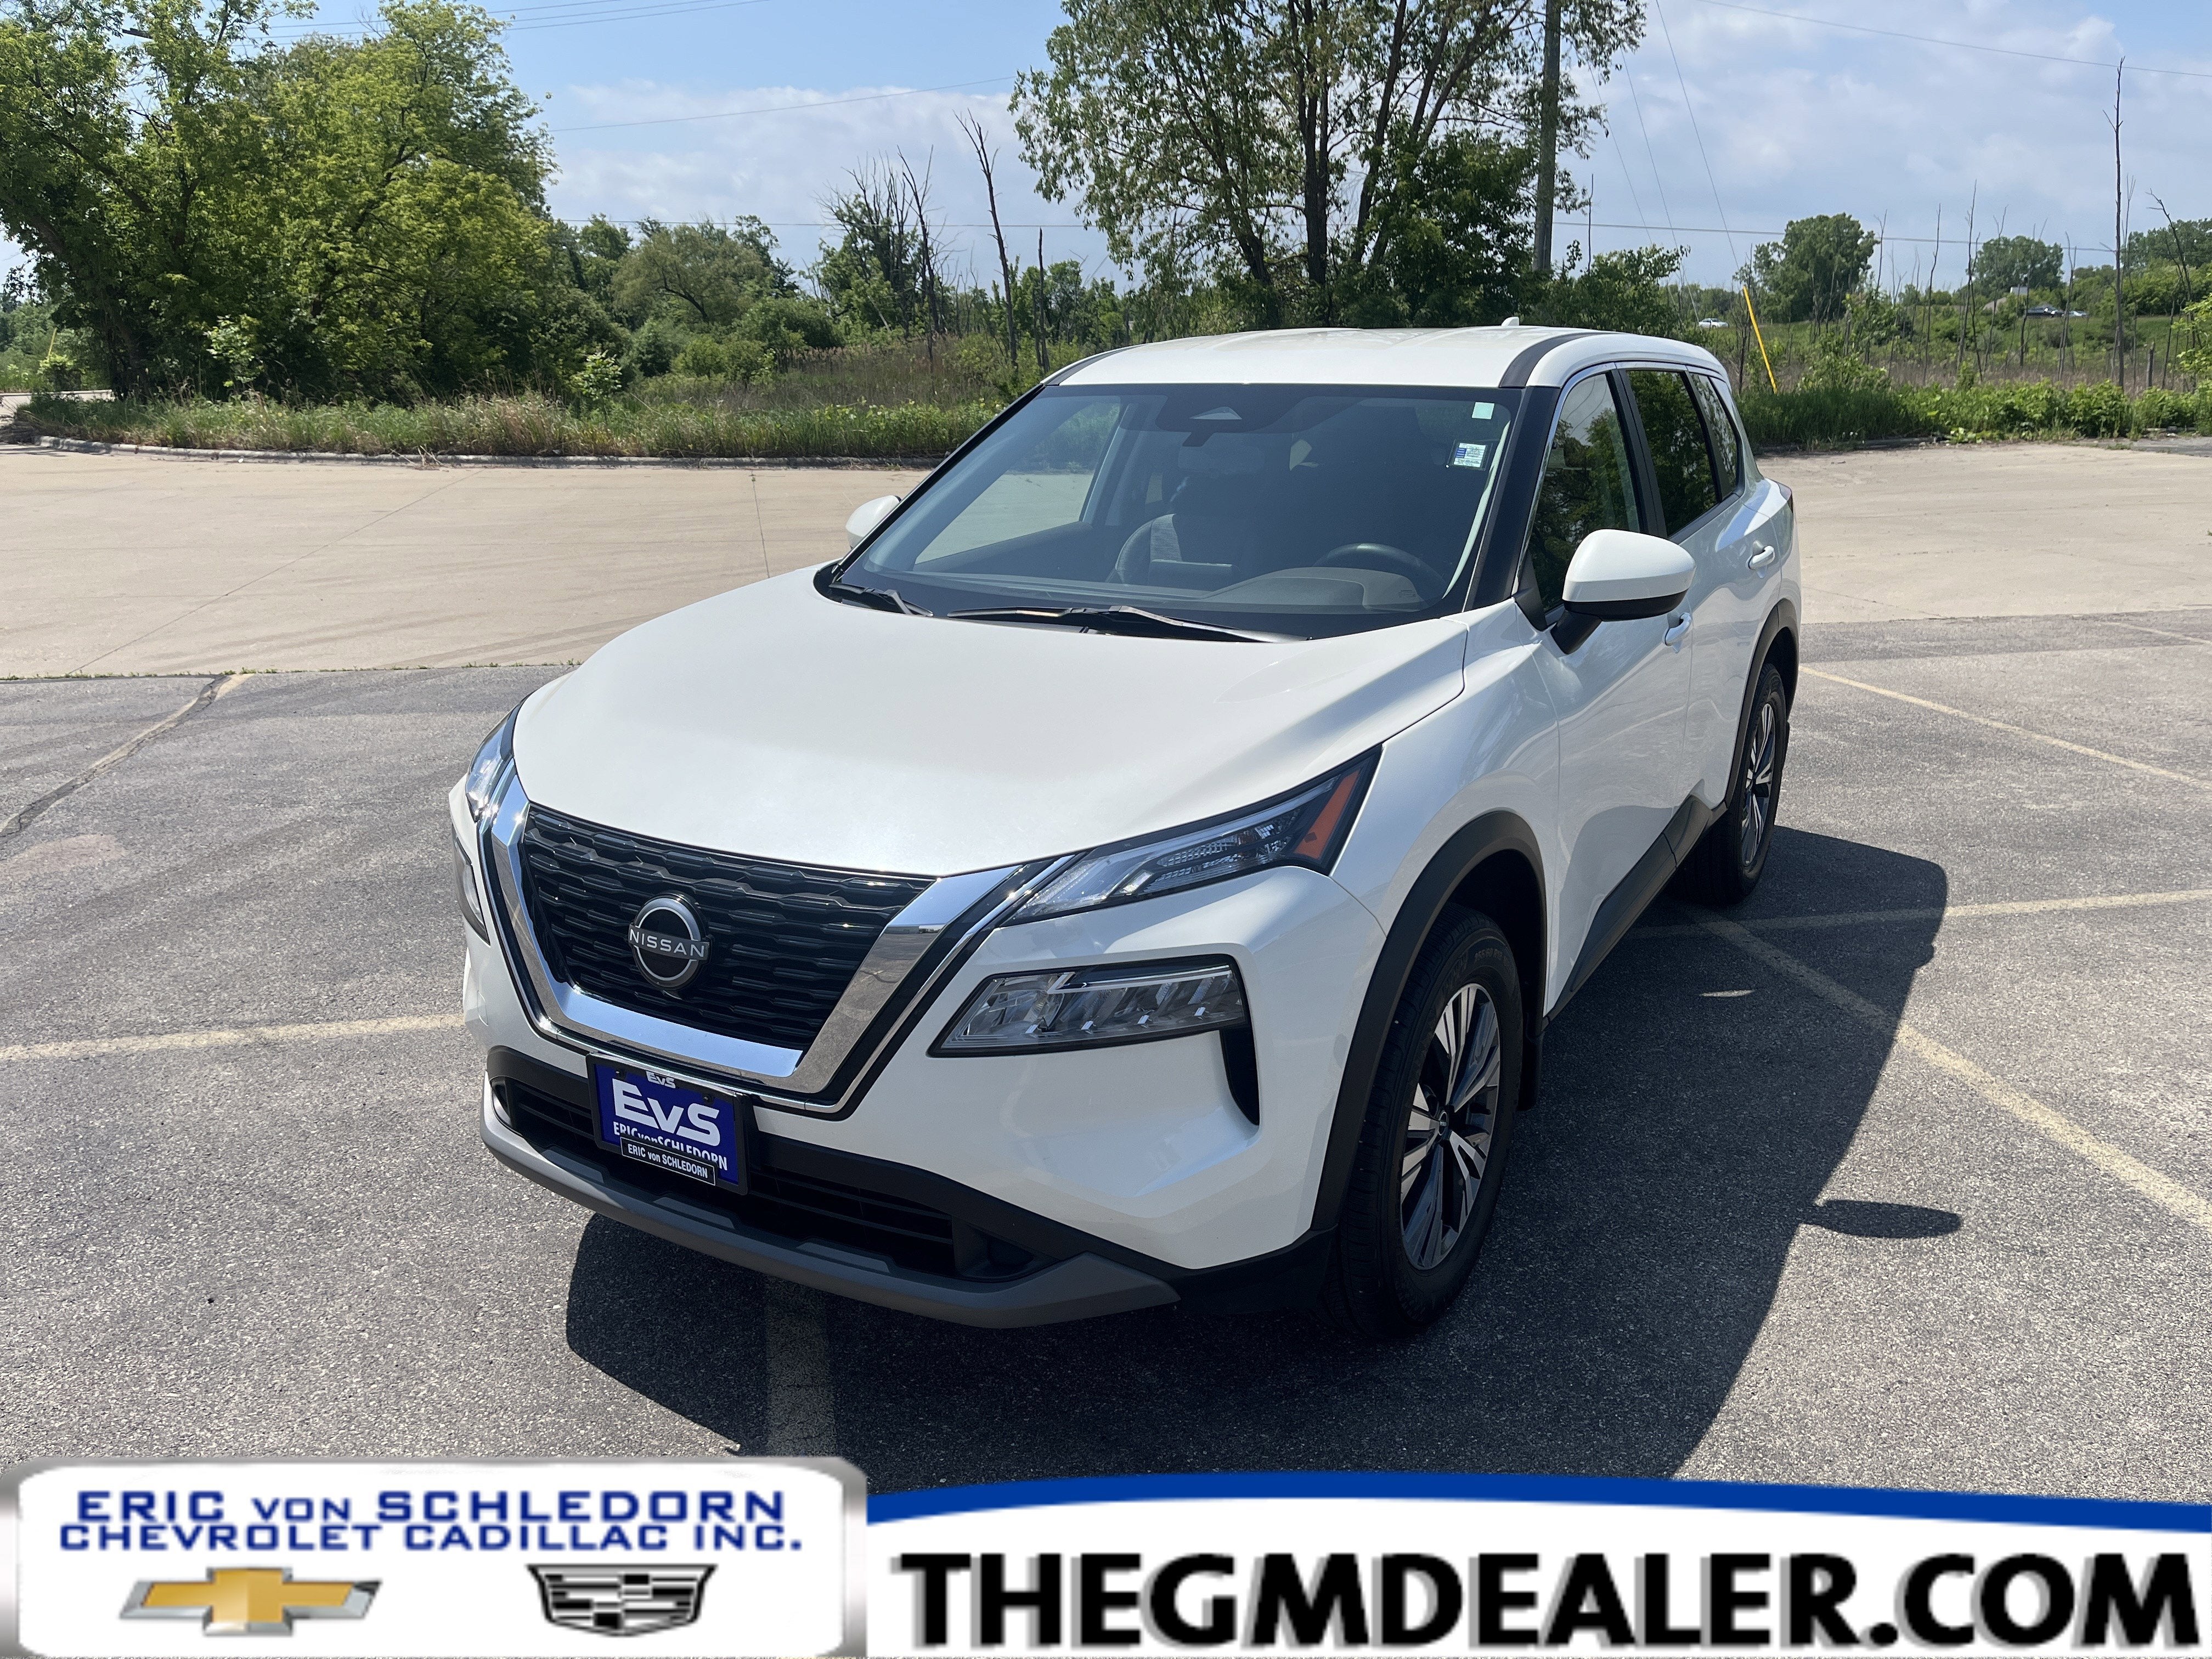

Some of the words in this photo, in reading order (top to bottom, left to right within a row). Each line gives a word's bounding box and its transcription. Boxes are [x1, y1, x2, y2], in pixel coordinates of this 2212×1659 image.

[629, 928, 704, 958] NISSAN
[628, 1143, 646, 1158] ERIC
[647, 1151, 661, 1163] von
[662, 1154, 708, 1178] SCHLEDORN
